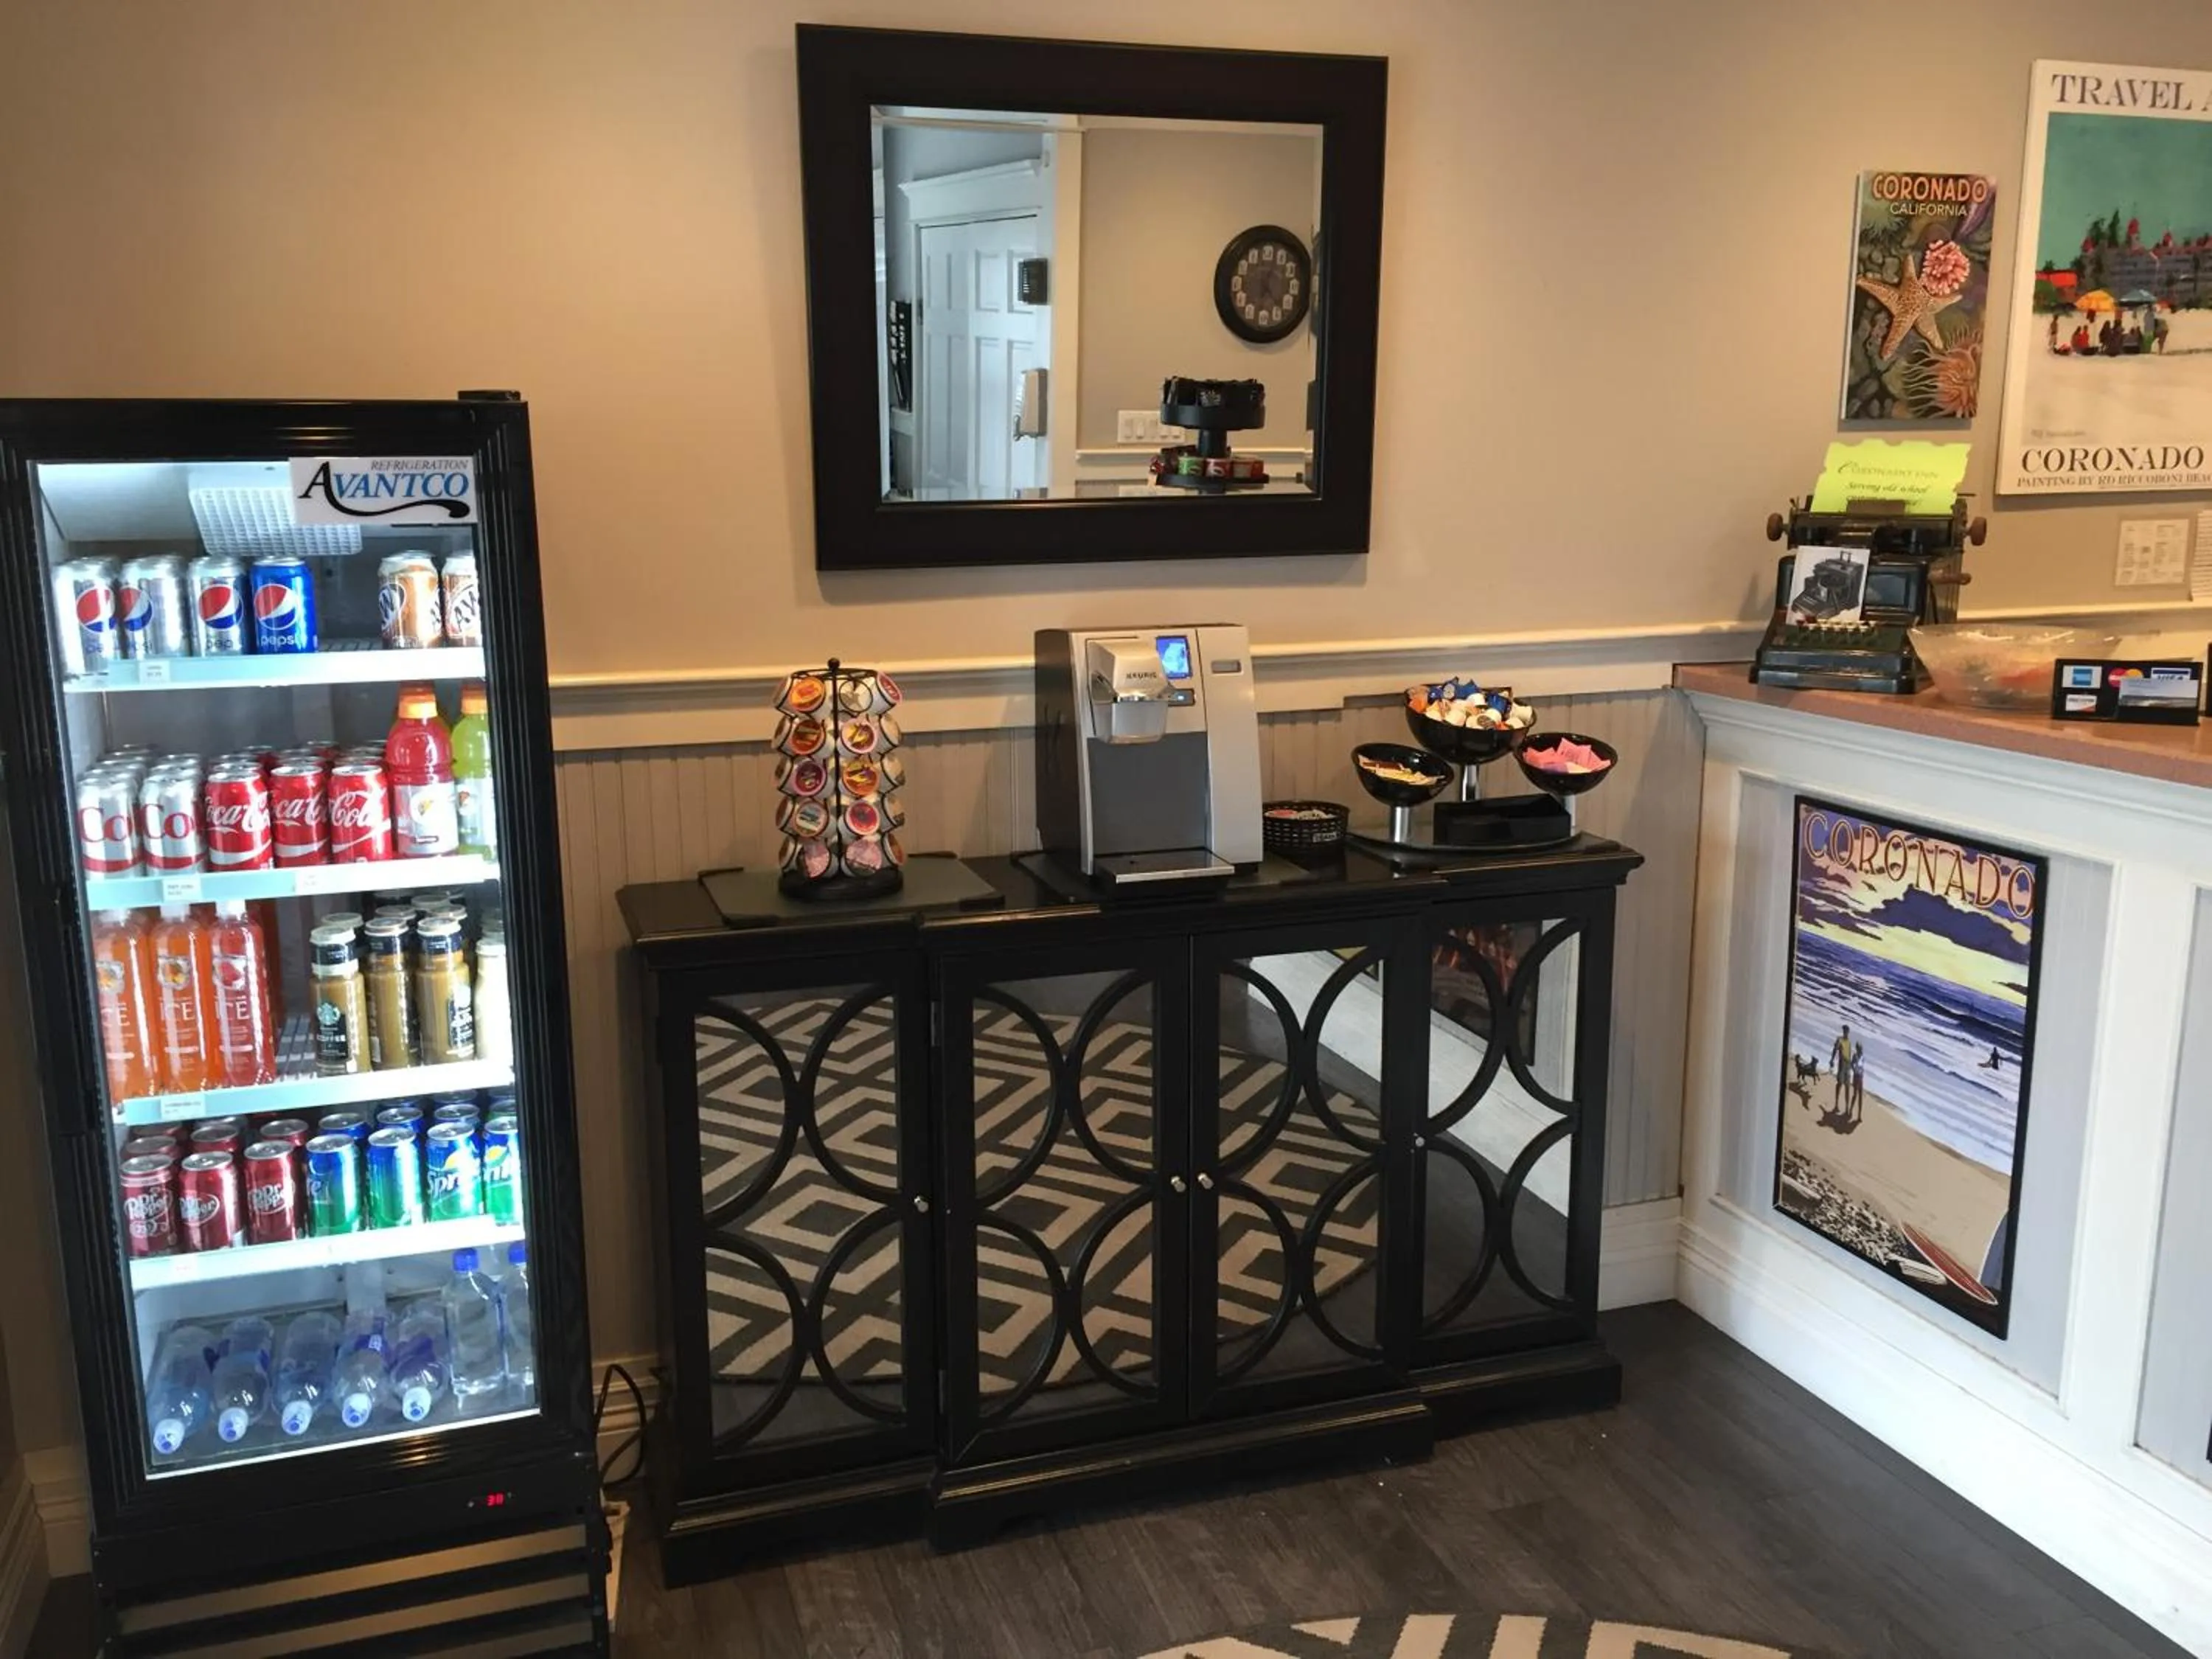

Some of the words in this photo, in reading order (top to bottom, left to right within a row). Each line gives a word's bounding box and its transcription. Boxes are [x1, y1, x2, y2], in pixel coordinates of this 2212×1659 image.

[2051, 74, 2192, 111] TRAVEL
[1872, 173, 1988, 203] CORONADO
[1890, 202, 1968, 216] CALIFORNIA
[371, 459, 468, 470] REFRIGERATION
[2021, 445, 2205, 473] CORONADO
[297, 461, 470, 518] AVANTCO
[2017, 476, 2076, 487] PAINTING
[2078, 475, 2094, 486] BY
[260, 635, 299, 648] peps
[1806, 813, 2036, 919] CORONADO
